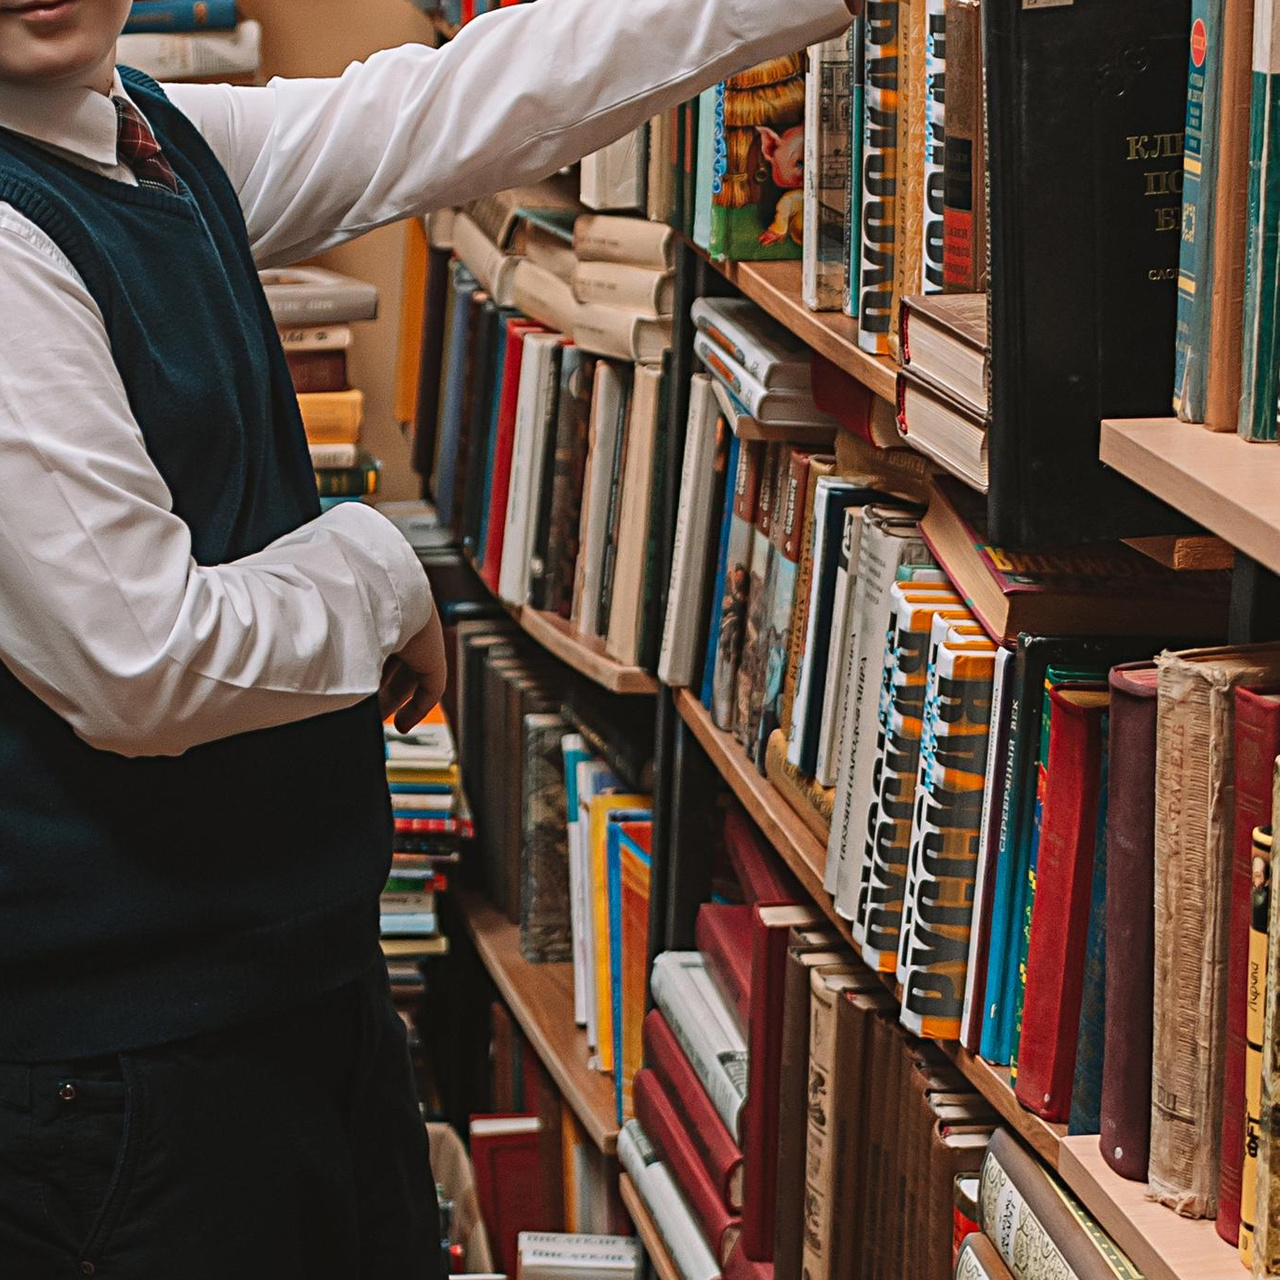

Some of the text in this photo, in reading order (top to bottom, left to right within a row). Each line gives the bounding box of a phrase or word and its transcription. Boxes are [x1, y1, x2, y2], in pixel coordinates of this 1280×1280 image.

[854, 656, 868, 705] МИРА
[847, 707, 862, 789] НАРОДОВ
[998, 699, 1020, 853] СЕРЕБРЯНЫЙ ВЕК
[906, 674, 993, 1019] РУССКАЯ
